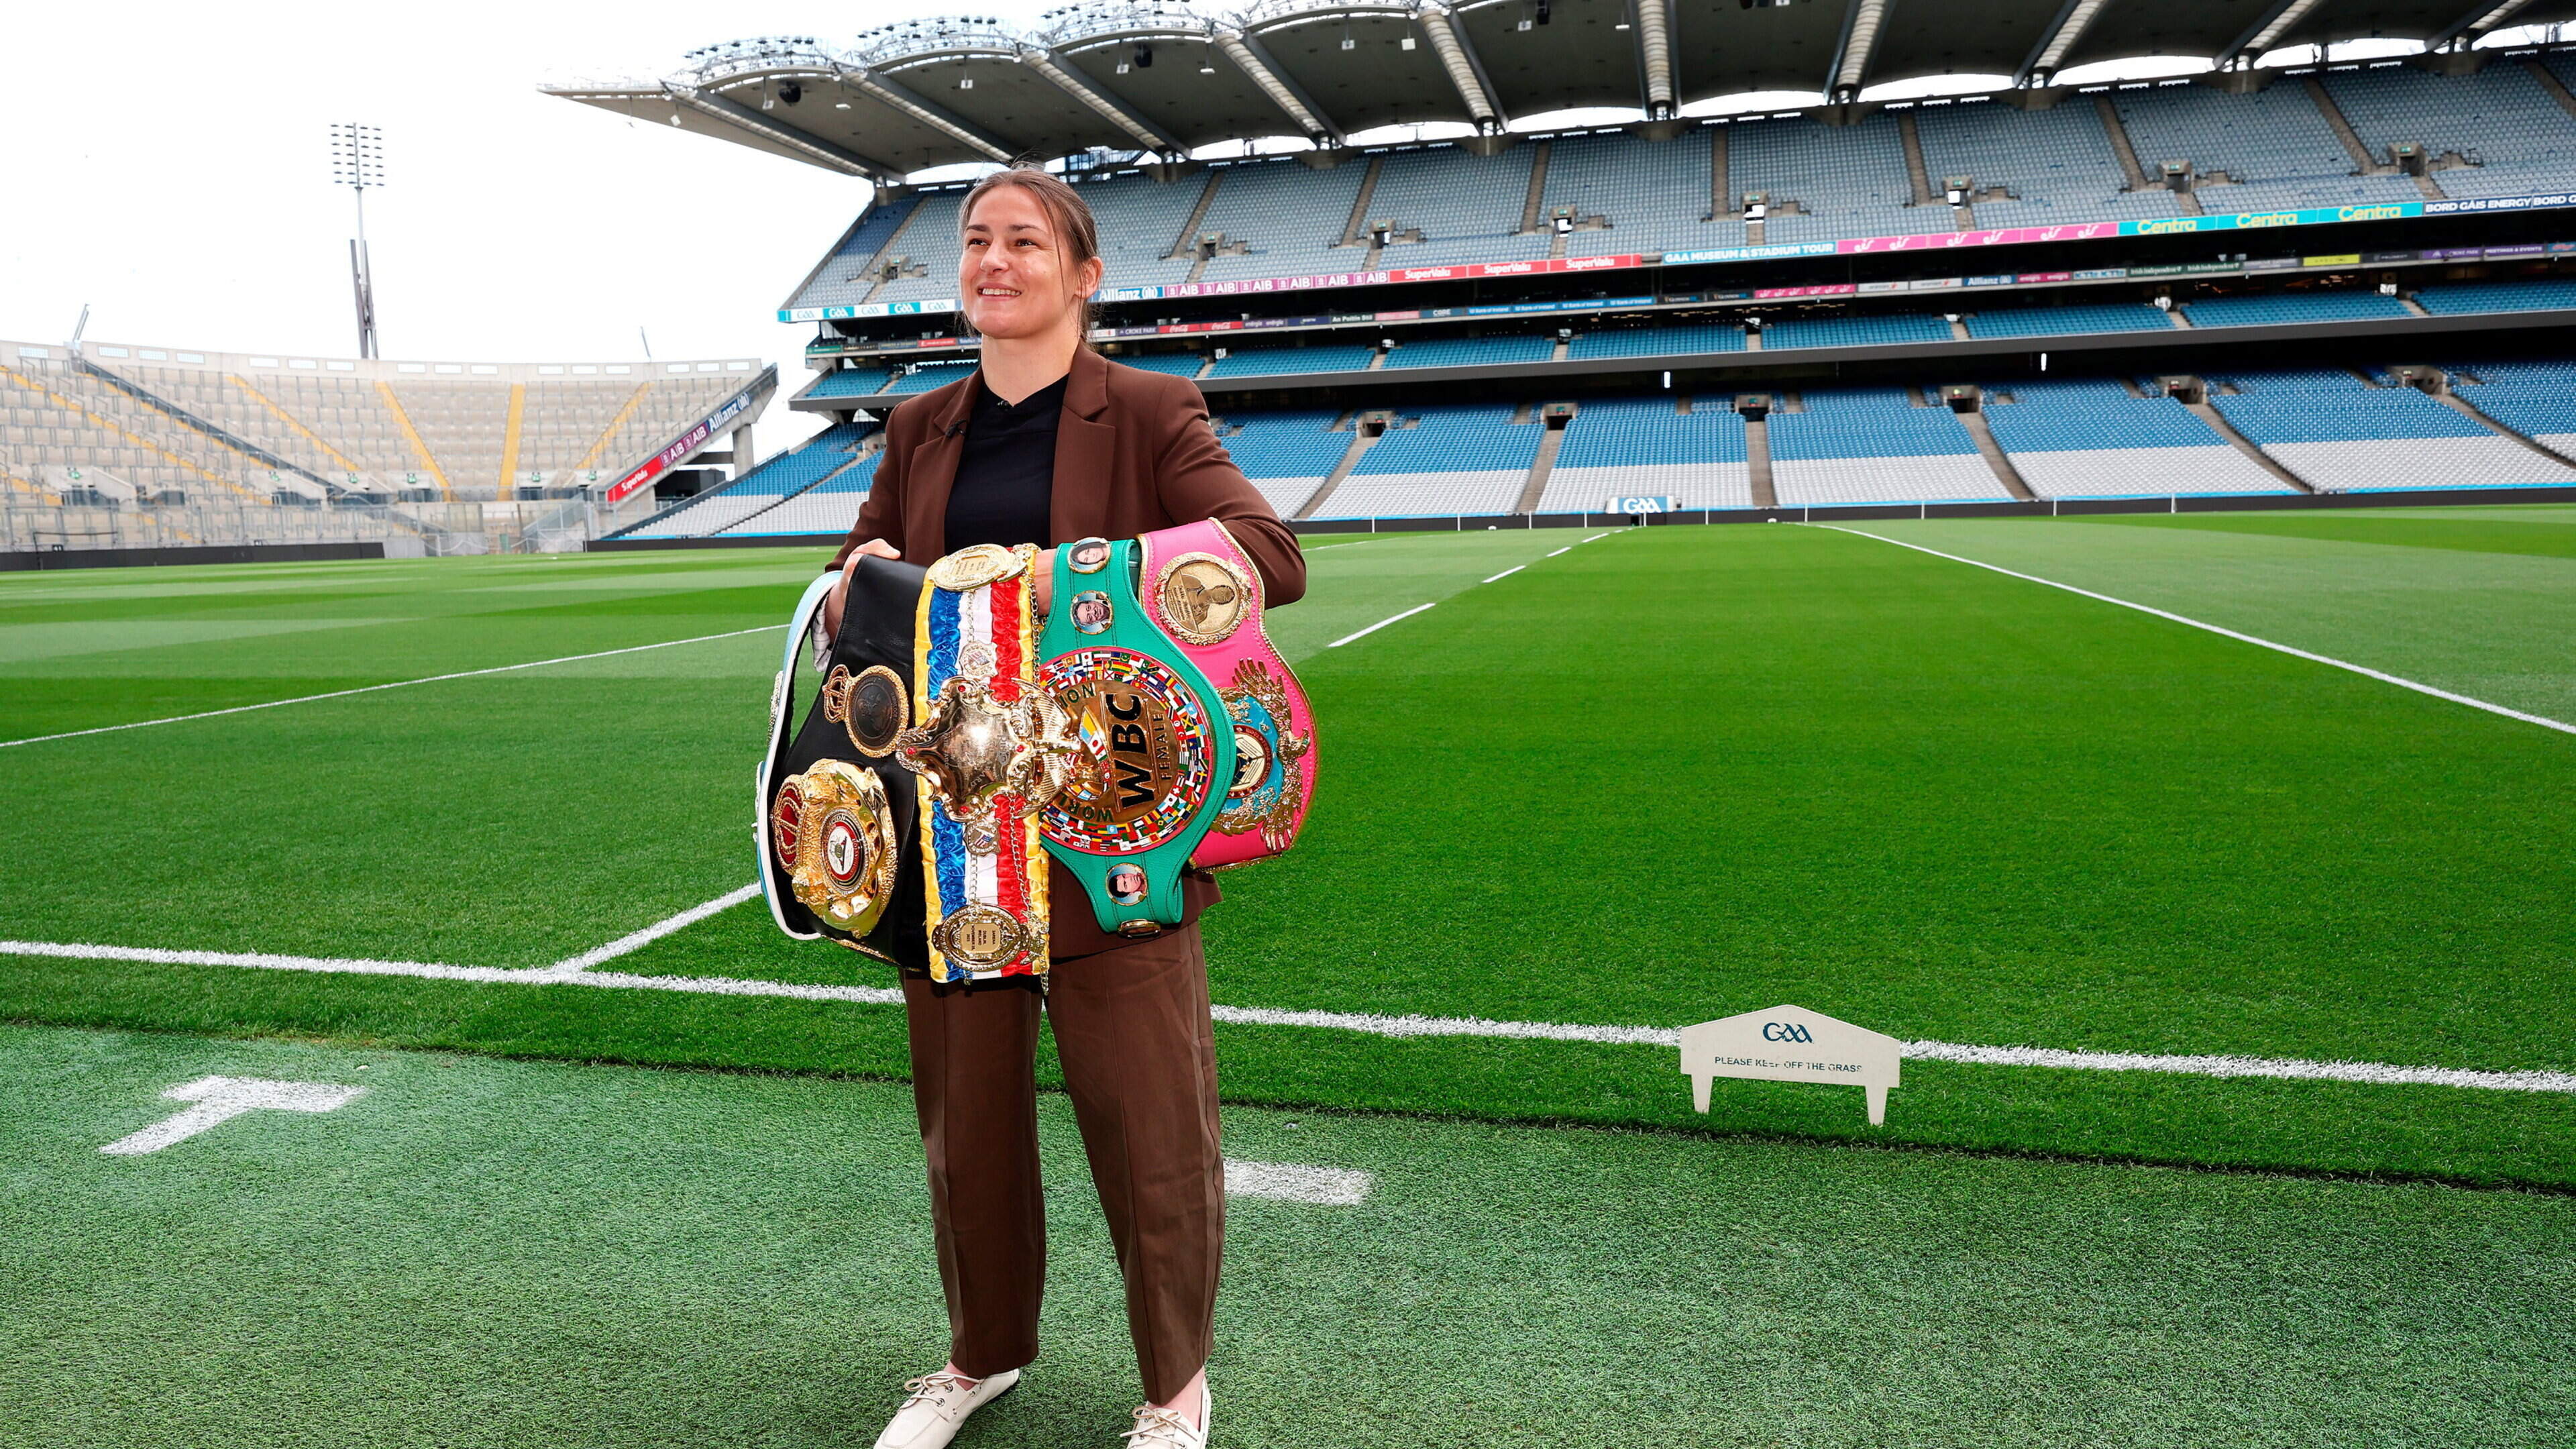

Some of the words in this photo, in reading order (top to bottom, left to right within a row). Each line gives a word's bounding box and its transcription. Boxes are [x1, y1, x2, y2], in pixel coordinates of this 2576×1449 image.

[2426, 201, 2457, 213] BORD
[2488, 197, 2531, 209] ENERGY
[2533, 195, 2567, 206] BORD
[2236, 213, 2298, 228] Centra
[2339, 206, 2402, 221] Centra
[2137, 219, 2197, 235] Centra
[1665, 252, 1690, 262] GAA
[1690, 249, 1738, 261] MUSEUM
[1739, 248, 1750, 259] &
[1750, 245, 1800, 258] STADIUM
[1803, 243, 1834, 253] TOUR
[1484, 262, 1532, 276] SuperValu
[1566, 257, 1615, 271] SuperValu
[1328, 275, 1348, 286] AIB
[1366, 272, 1387, 282] AIB
[1405, 269, 1451, 281] SuperValu
[1968, 276, 1998, 285] Allianz
[1179, 286, 1199, 295] AIB
[1216, 283, 1236, 294] AIB
[1253, 280, 1273, 291] AIB
[1291, 278, 1310, 288] AIB
[1099, 287, 1140, 301] Allianz
[708, 402, 739, 433] Allianz
[693, 423, 707, 443] AIB
[670, 444, 685, 461] AIB
[1105, 693, 1157, 810] WBC
[1153, 712, 1173, 781] FEMALE
[1059, 794, 1114, 822] WORL
[1762, 1022, 1814, 1044] GAA
[1715, 1057, 1752, 1067] PLEASE
[1783, 1061, 1803, 1069] OFF
[1806, 1062, 1825, 1071] THE
[1828, 1063, 1863, 1073] GRASS
